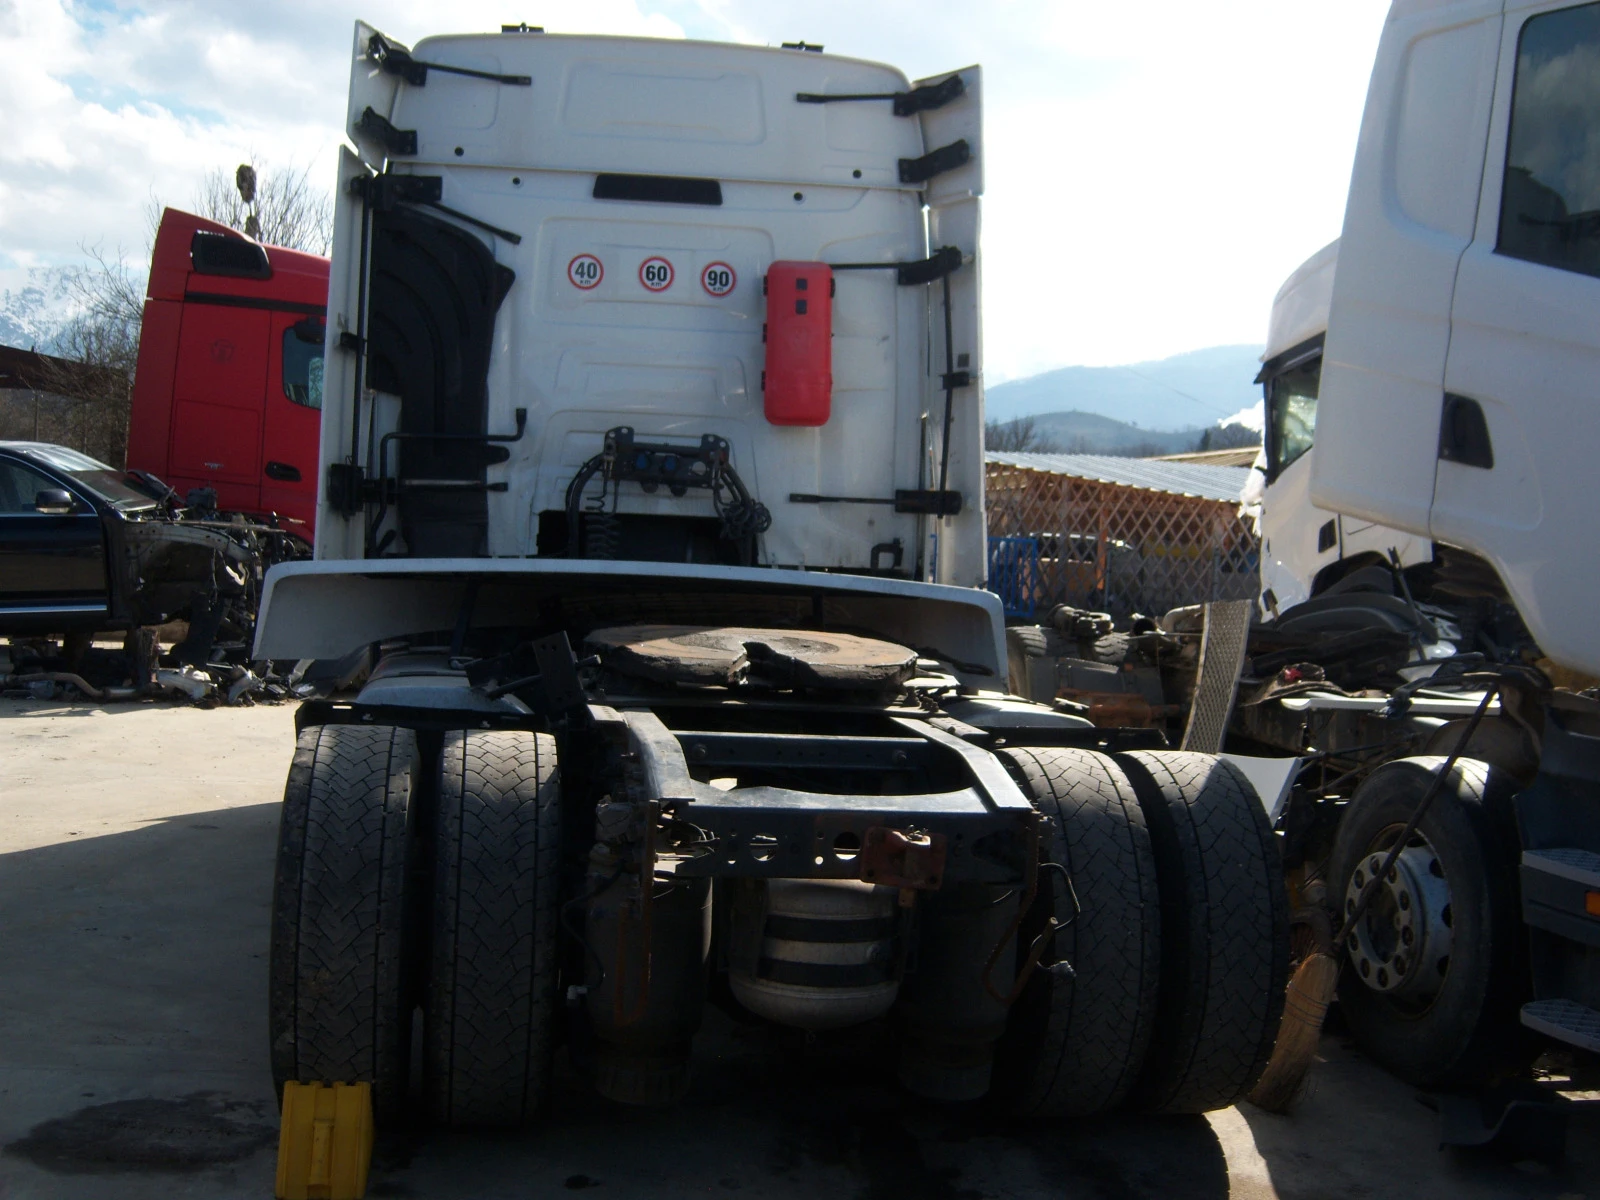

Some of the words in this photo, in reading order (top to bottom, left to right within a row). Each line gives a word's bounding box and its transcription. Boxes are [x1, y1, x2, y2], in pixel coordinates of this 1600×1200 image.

[575, 262, 597, 279] 40
[645, 265, 667, 282] 60
[708, 270, 729, 287] 90
